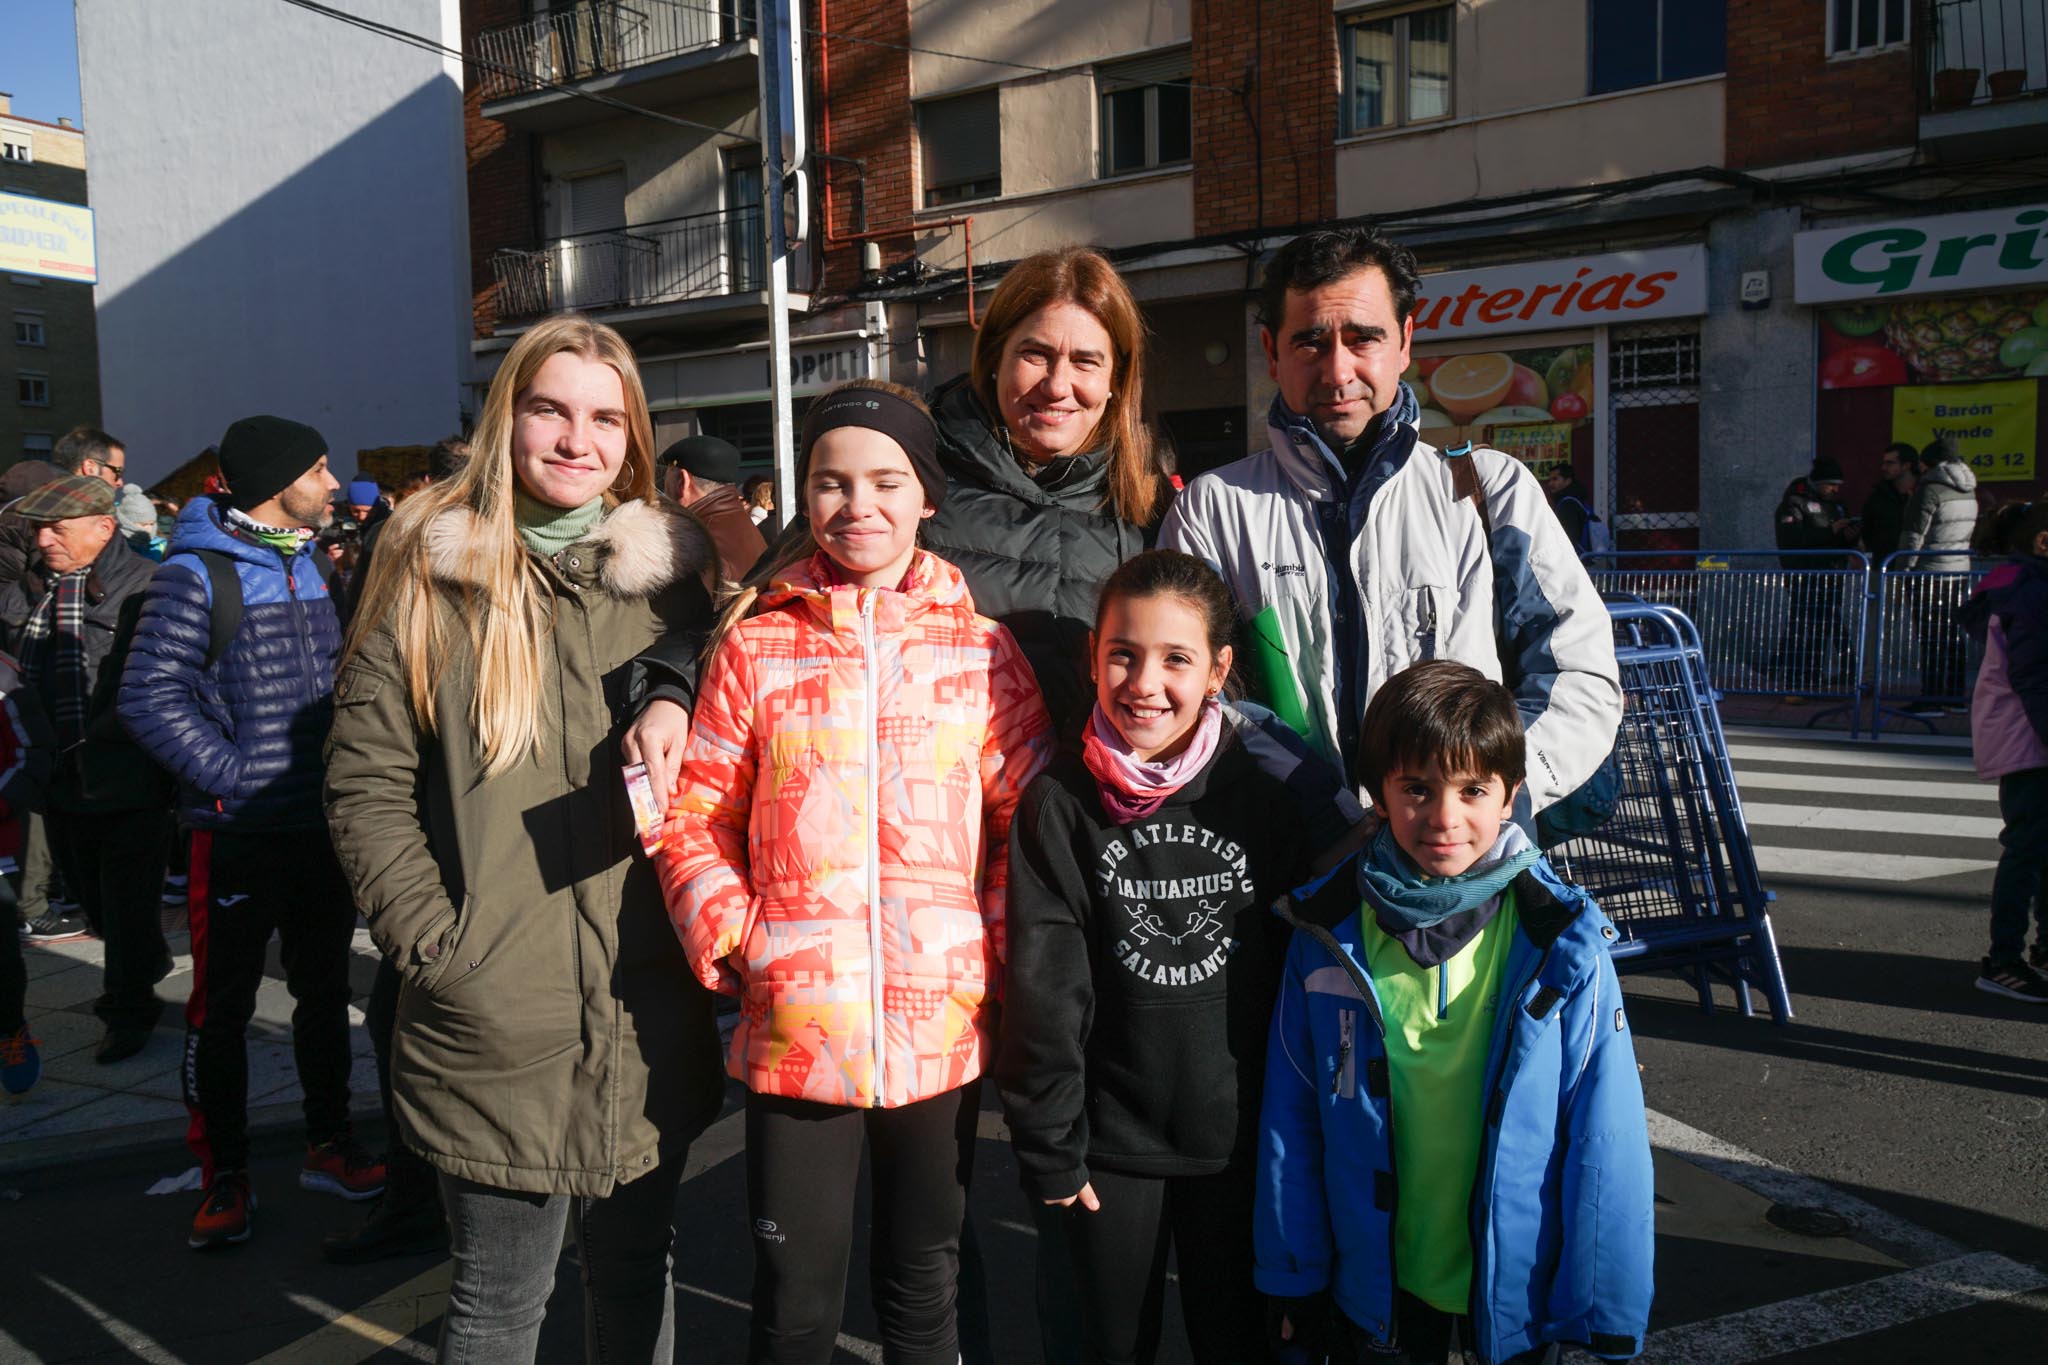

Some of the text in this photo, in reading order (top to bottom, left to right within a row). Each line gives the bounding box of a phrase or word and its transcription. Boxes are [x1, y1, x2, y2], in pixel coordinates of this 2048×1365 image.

[1822, 210, 2048, 293] Gri
[1934, 403, 1993, 418] Barón
[1223, 421, 1232, 433] 2
[1971, 455, 1994, 467] 43
[2003, 453, 2025, 466] 12
[1113, 936, 1241, 985] SALAMANCA
